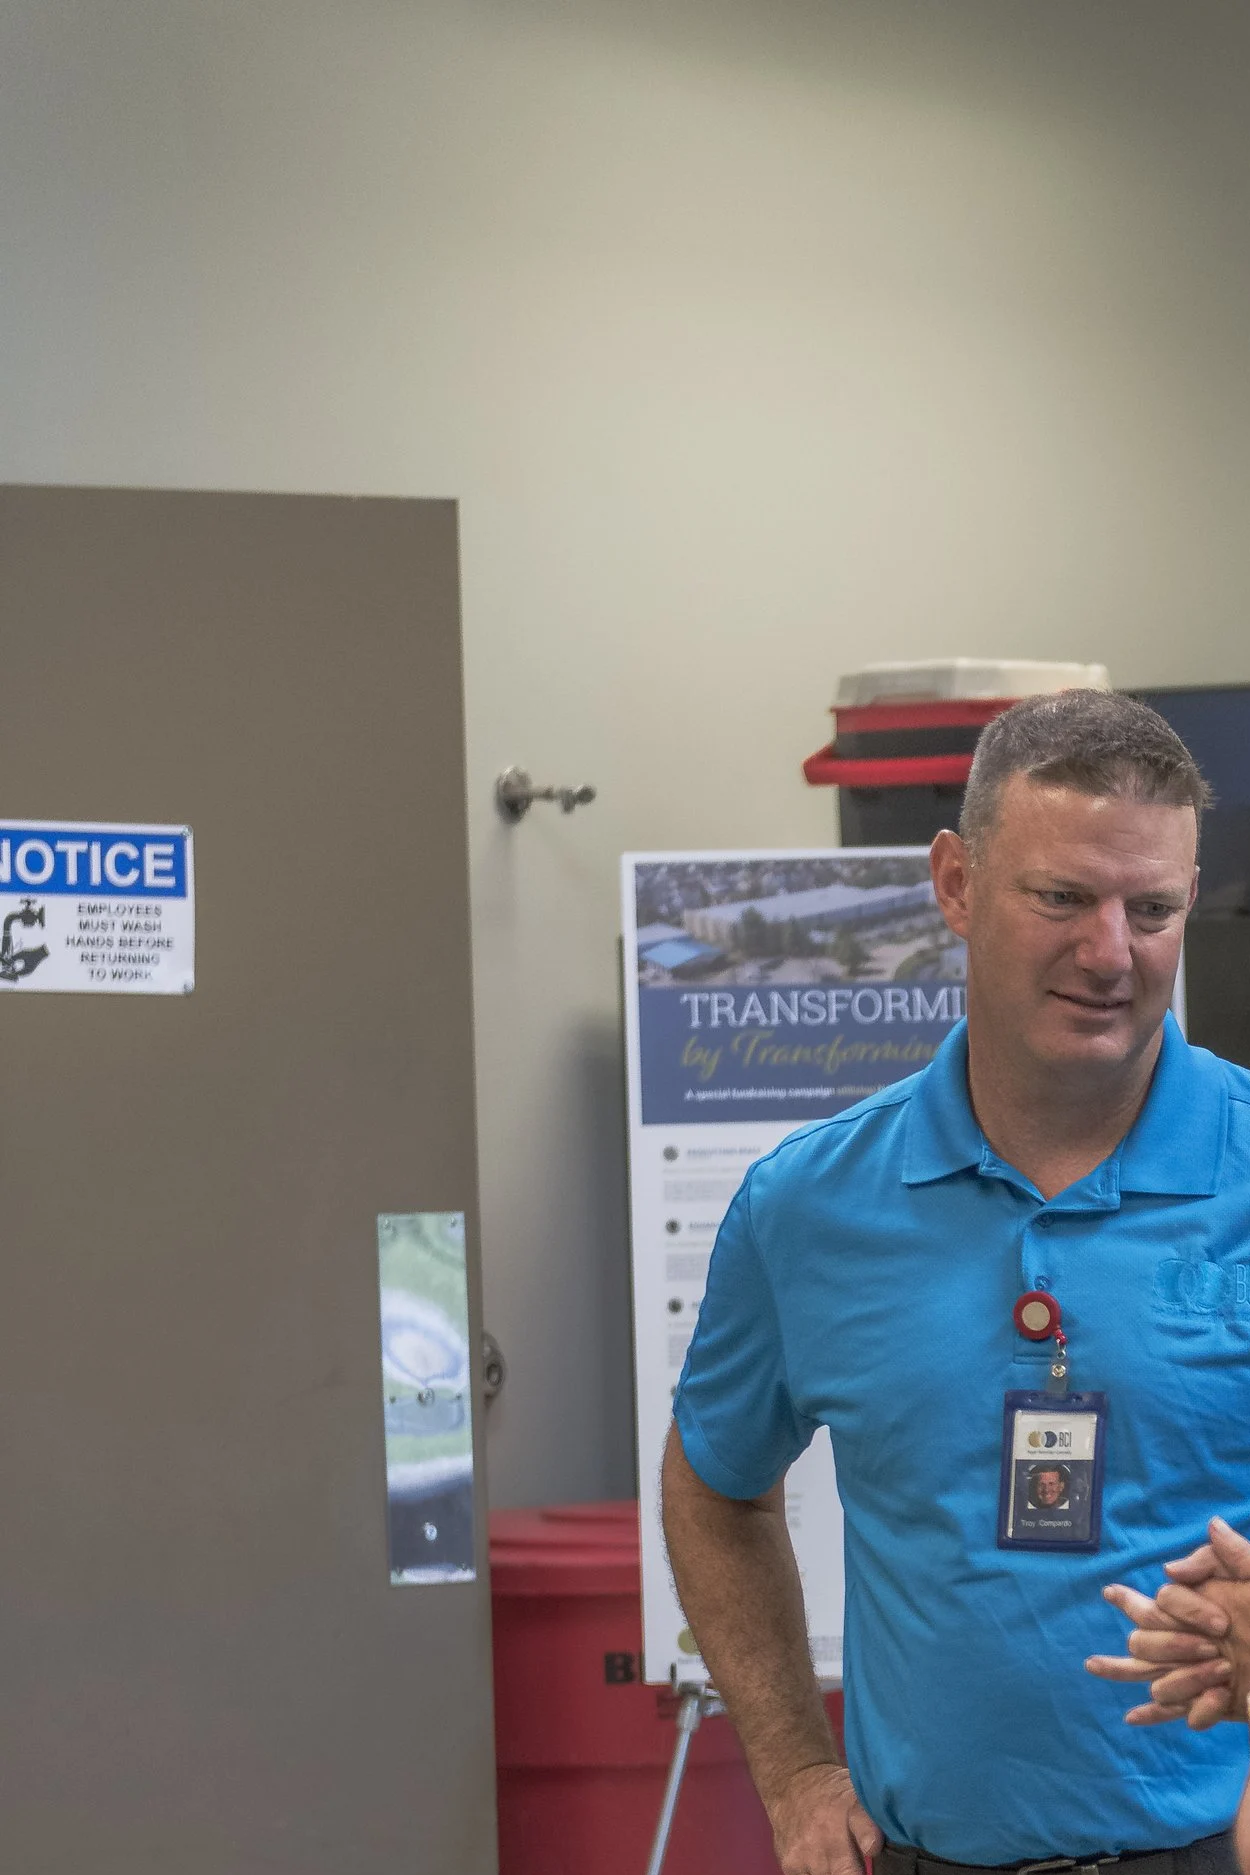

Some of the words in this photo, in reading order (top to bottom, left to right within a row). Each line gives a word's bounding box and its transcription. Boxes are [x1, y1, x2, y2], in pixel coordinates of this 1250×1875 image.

[77, 903, 162, 917] EMPLOYEES
[79, 920, 115, 932] MUST
[122, 921, 162, 932] WASH
[66, 935, 114, 949] HANDS
[119, 937, 174, 949] BEFORE
[80, 952, 160, 966] RETURNING
[89, 968, 107, 980] TO
[112, 968, 152, 980] WORK
[680, 987, 967, 1028] TRANSFORMI
[681, 1036, 722, 1082] by
[731, 1029, 937, 1076] Transformin
[684, 1088, 695, 1099] A
[696, 1087, 731, 1100] special
[732, 1086, 787, 1100] fundraising
[788, 1085, 834, 1098] campaign
[1058, 1431, 1072, 1448] BCI
[1021, 1519, 1036, 1528] Troy
